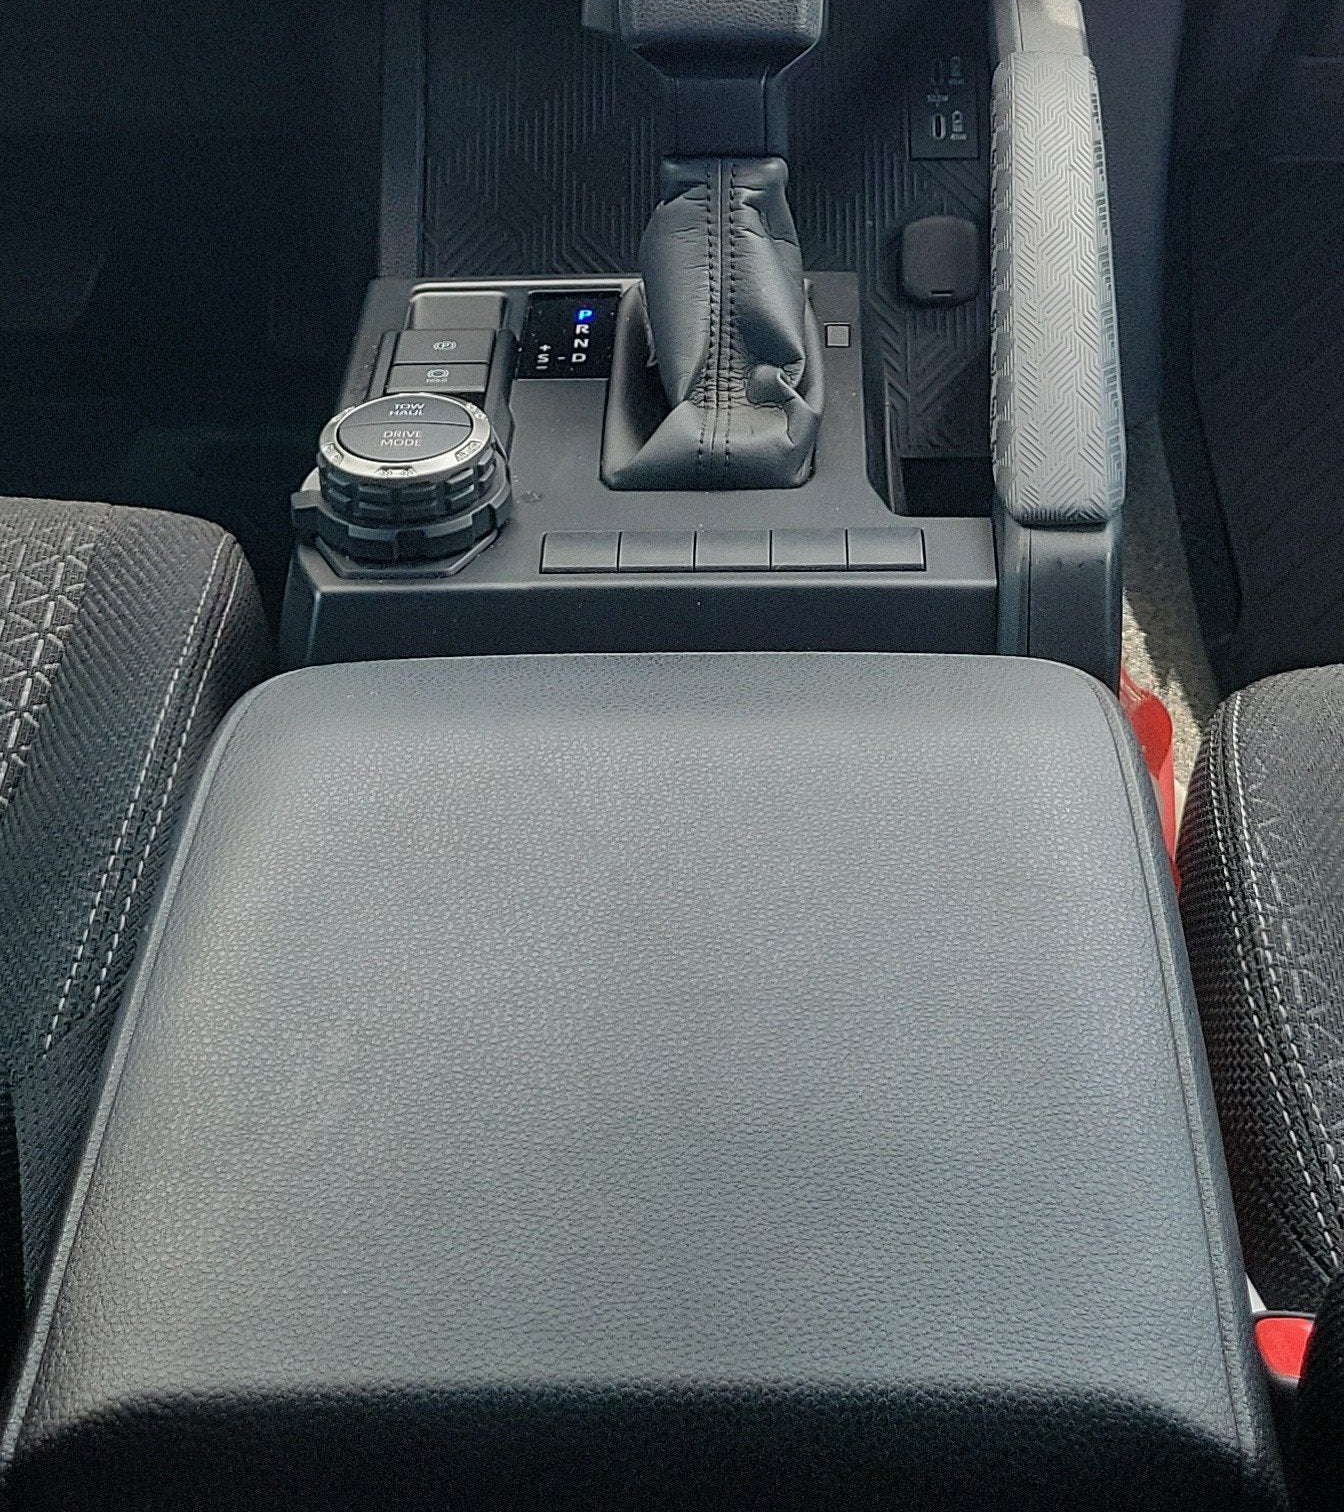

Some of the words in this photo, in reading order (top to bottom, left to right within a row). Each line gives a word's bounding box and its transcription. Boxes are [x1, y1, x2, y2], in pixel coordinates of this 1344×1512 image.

[578, 309, 593, 320] P
[575, 324, 590, 335] R
[573, 338, 590, 349] N
[537, 353, 550, 364] S
[571, 352, 587, 363] D
[383, 430, 423, 438] DRIVE
[380, 439, 423, 447] MODE
